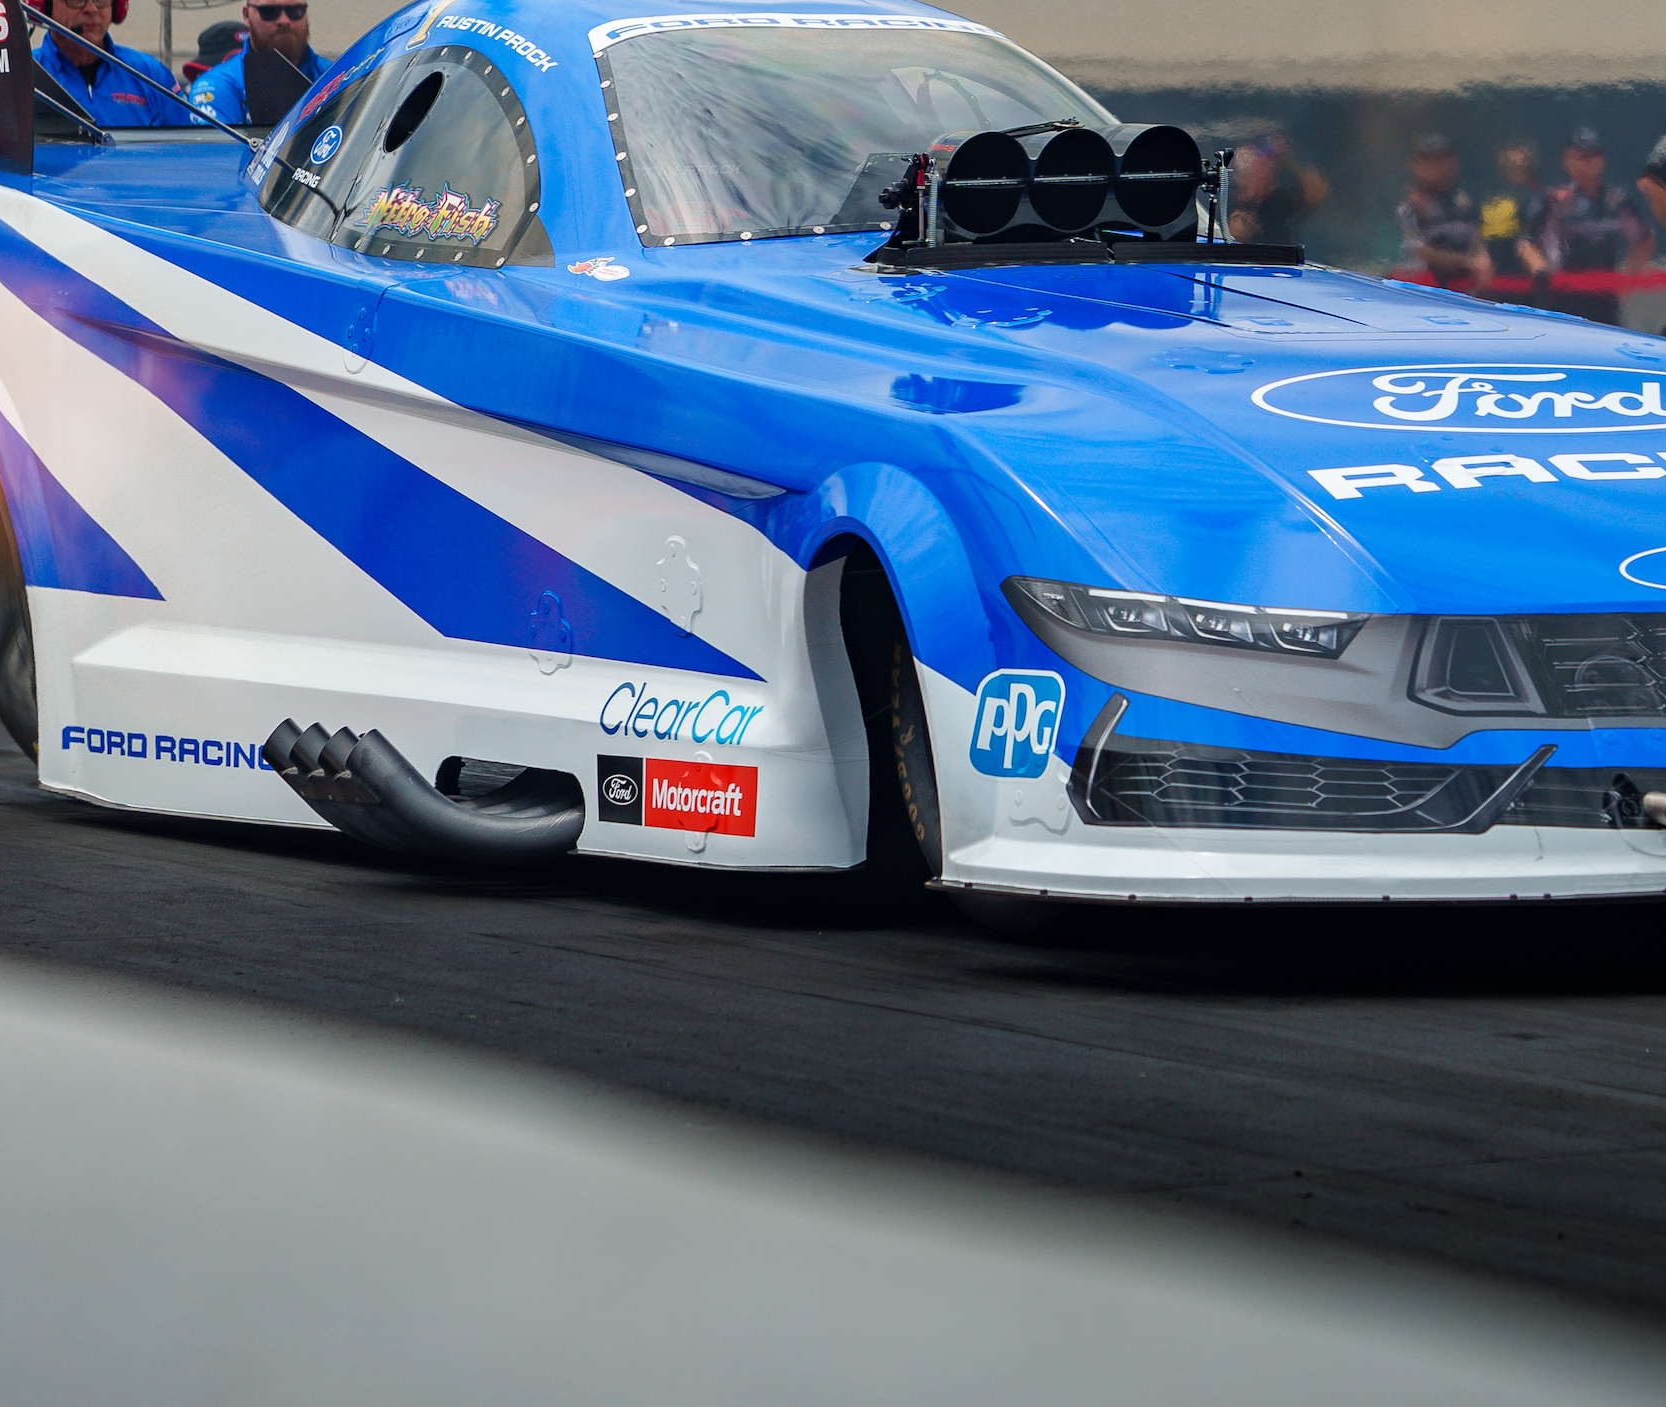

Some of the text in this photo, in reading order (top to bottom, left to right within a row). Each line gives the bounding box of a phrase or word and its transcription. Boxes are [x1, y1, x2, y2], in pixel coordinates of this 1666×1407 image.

[436, 15, 558, 72] AUSTIN PROCK
[606, 16, 779, 40] FORD
[291, 167, 322, 189] RACING
[430, 190, 496, 240] Fish
[599, 681, 765, 746] ClearCar
[976, 682, 1057, 770] PPG
[61, 725, 148, 759] FORD
[608, 777, 633, 801] Ford
[651, 778, 743, 817] Motorcraft
